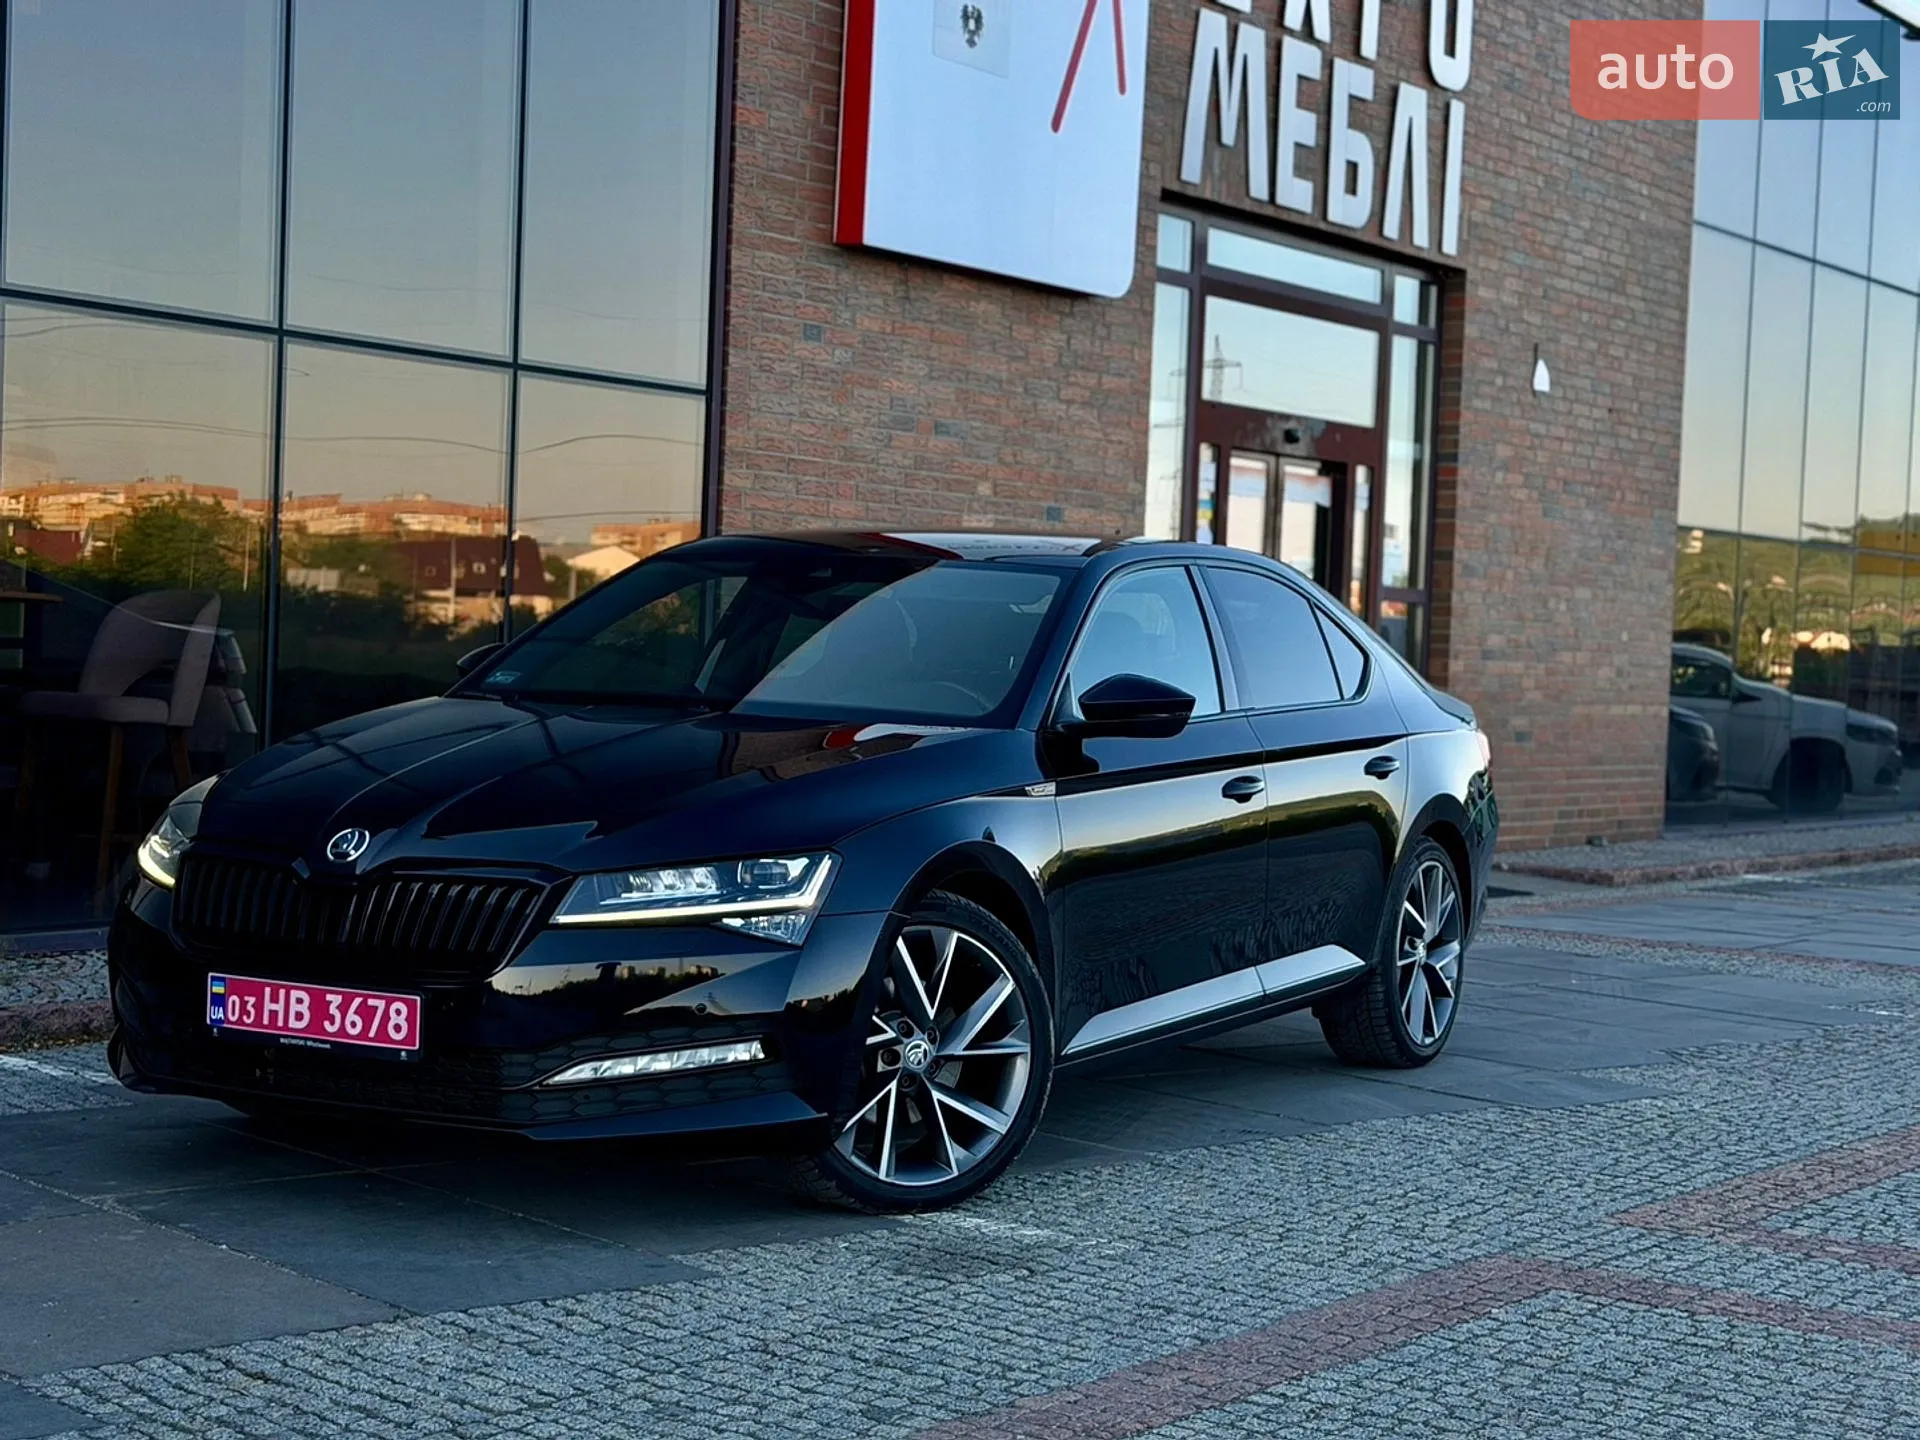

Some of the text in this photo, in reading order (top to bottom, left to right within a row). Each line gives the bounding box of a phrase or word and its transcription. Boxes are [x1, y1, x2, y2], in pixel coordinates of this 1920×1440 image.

[1180, 7, 1465, 256] МЕБЛІ
[210, 1006, 225, 1021] UA
[228, 995, 256, 1024] 03
[323, 994, 408, 1041] 3678
